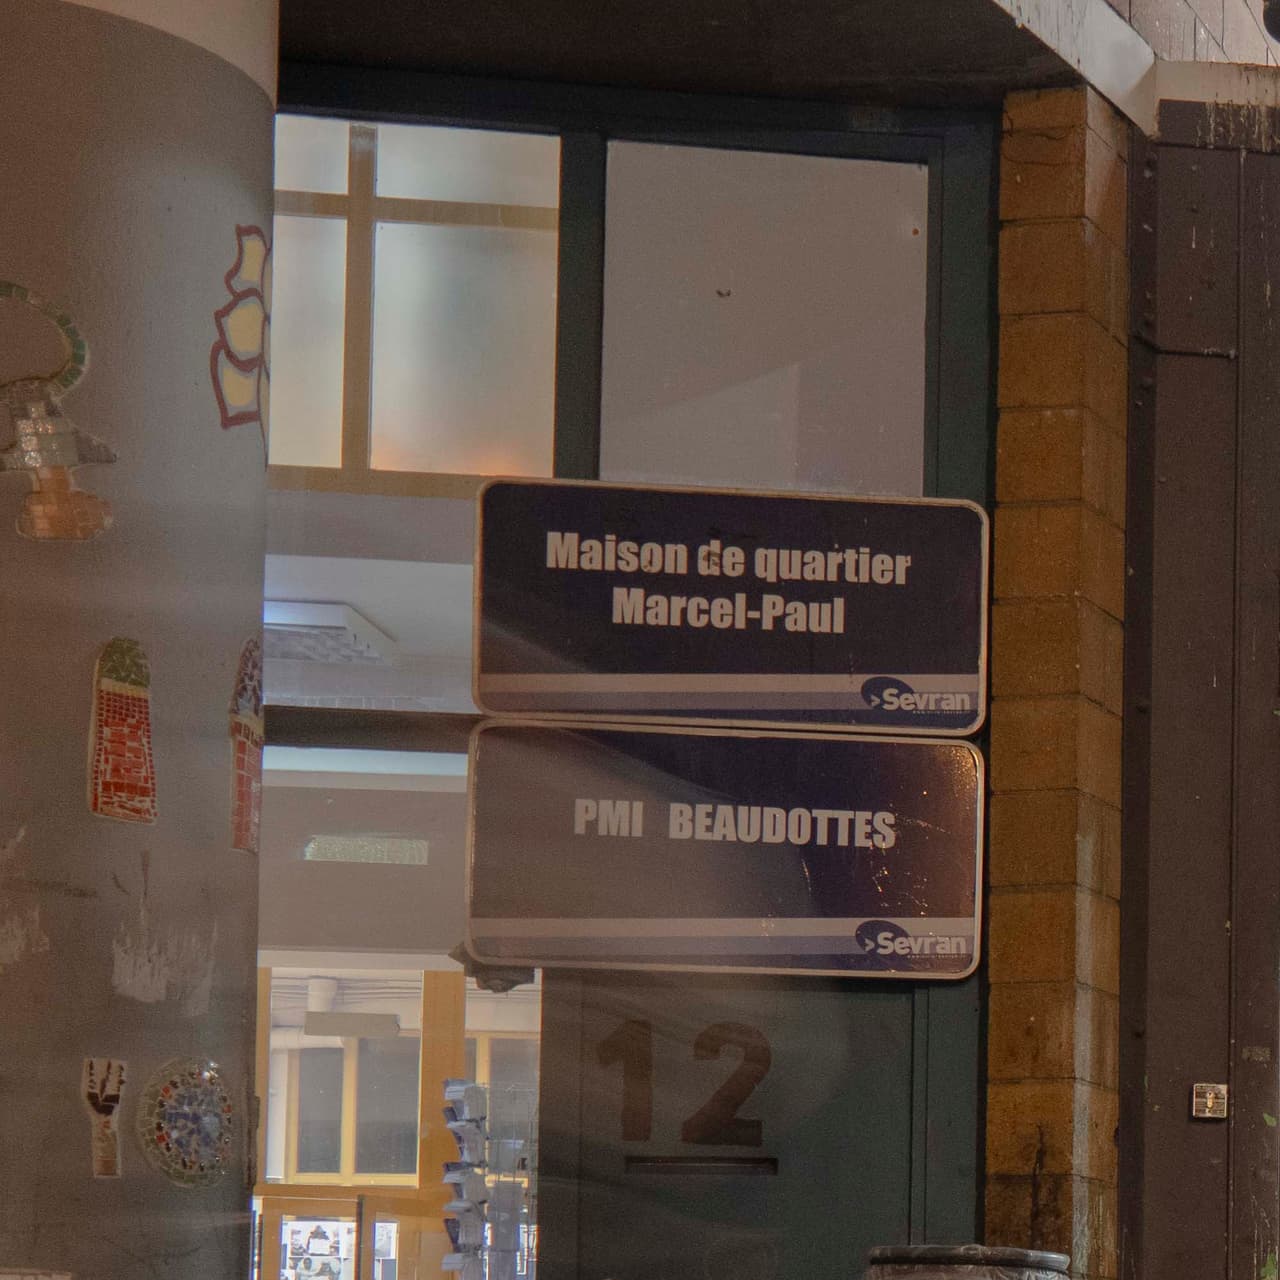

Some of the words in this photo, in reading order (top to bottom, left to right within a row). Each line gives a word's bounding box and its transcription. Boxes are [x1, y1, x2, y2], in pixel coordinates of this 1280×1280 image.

[545, 531, 688, 575] Maison
[698, 539, 745, 577] de
[753, 543, 911, 586] quartier
[611, 587, 845, 634] Marcel-Paul
[882, 686, 971, 712] Sevran
[574, 798, 643, 838] PMI
[668, 802, 897, 849] BEAUDOTTES
[877, 930, 967, 957] Sevran
[594, 1019, 773, 1147] 12
